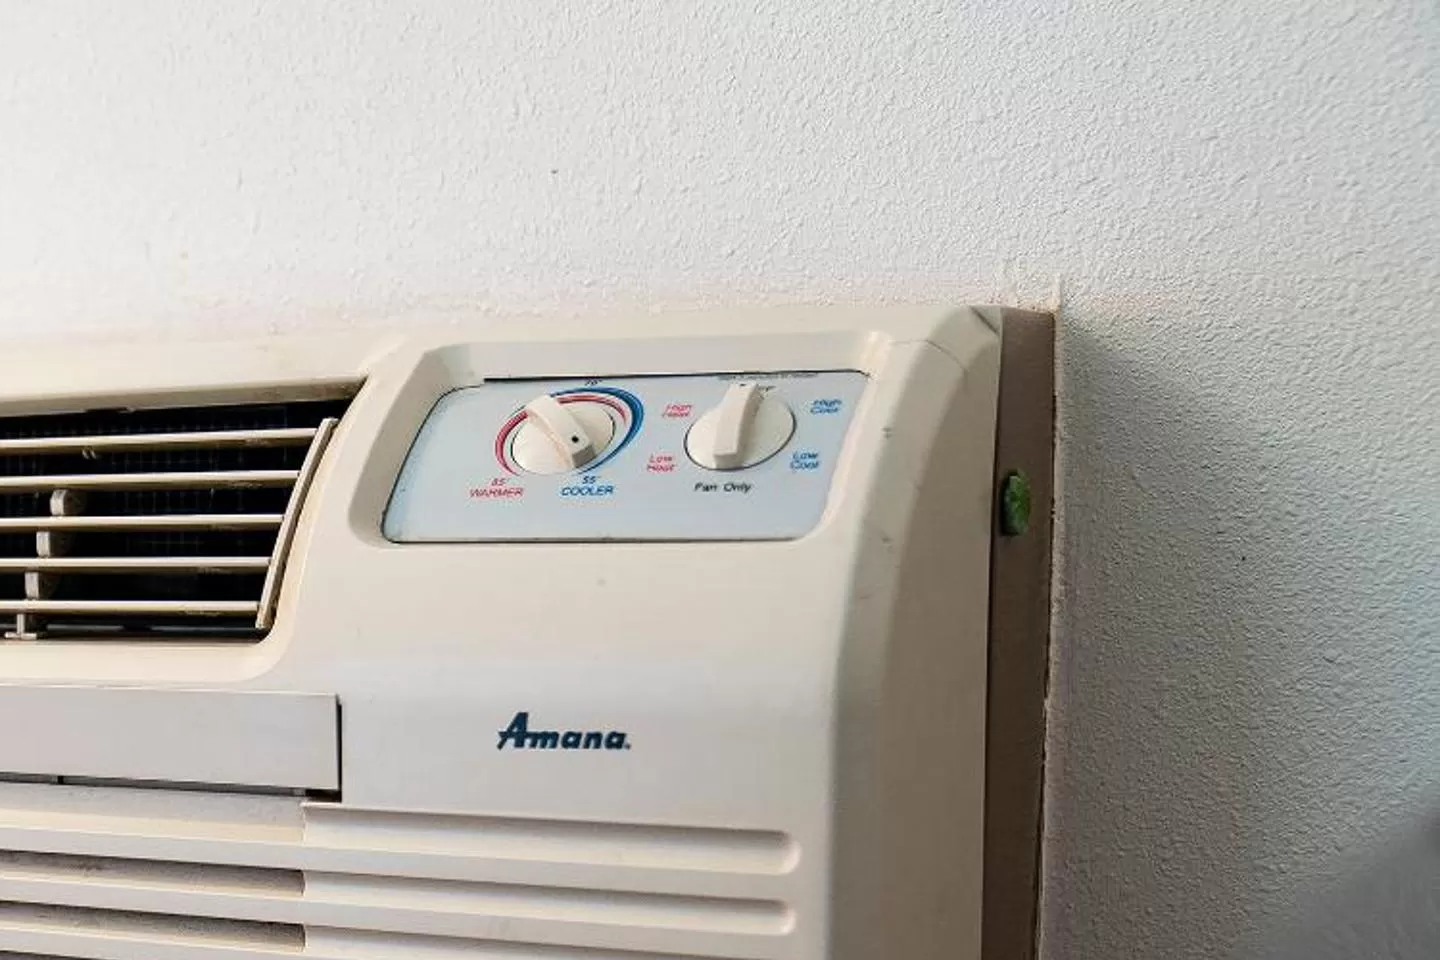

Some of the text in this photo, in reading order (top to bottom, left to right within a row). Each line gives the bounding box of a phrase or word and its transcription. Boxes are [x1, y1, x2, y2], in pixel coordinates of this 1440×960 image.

[470, 487, 523, 497] WARMER
[561, 485, 614, 496] COOLER
[694, 482, 753, 495] Fan Only
[497, 712, 627, 750] Amana
